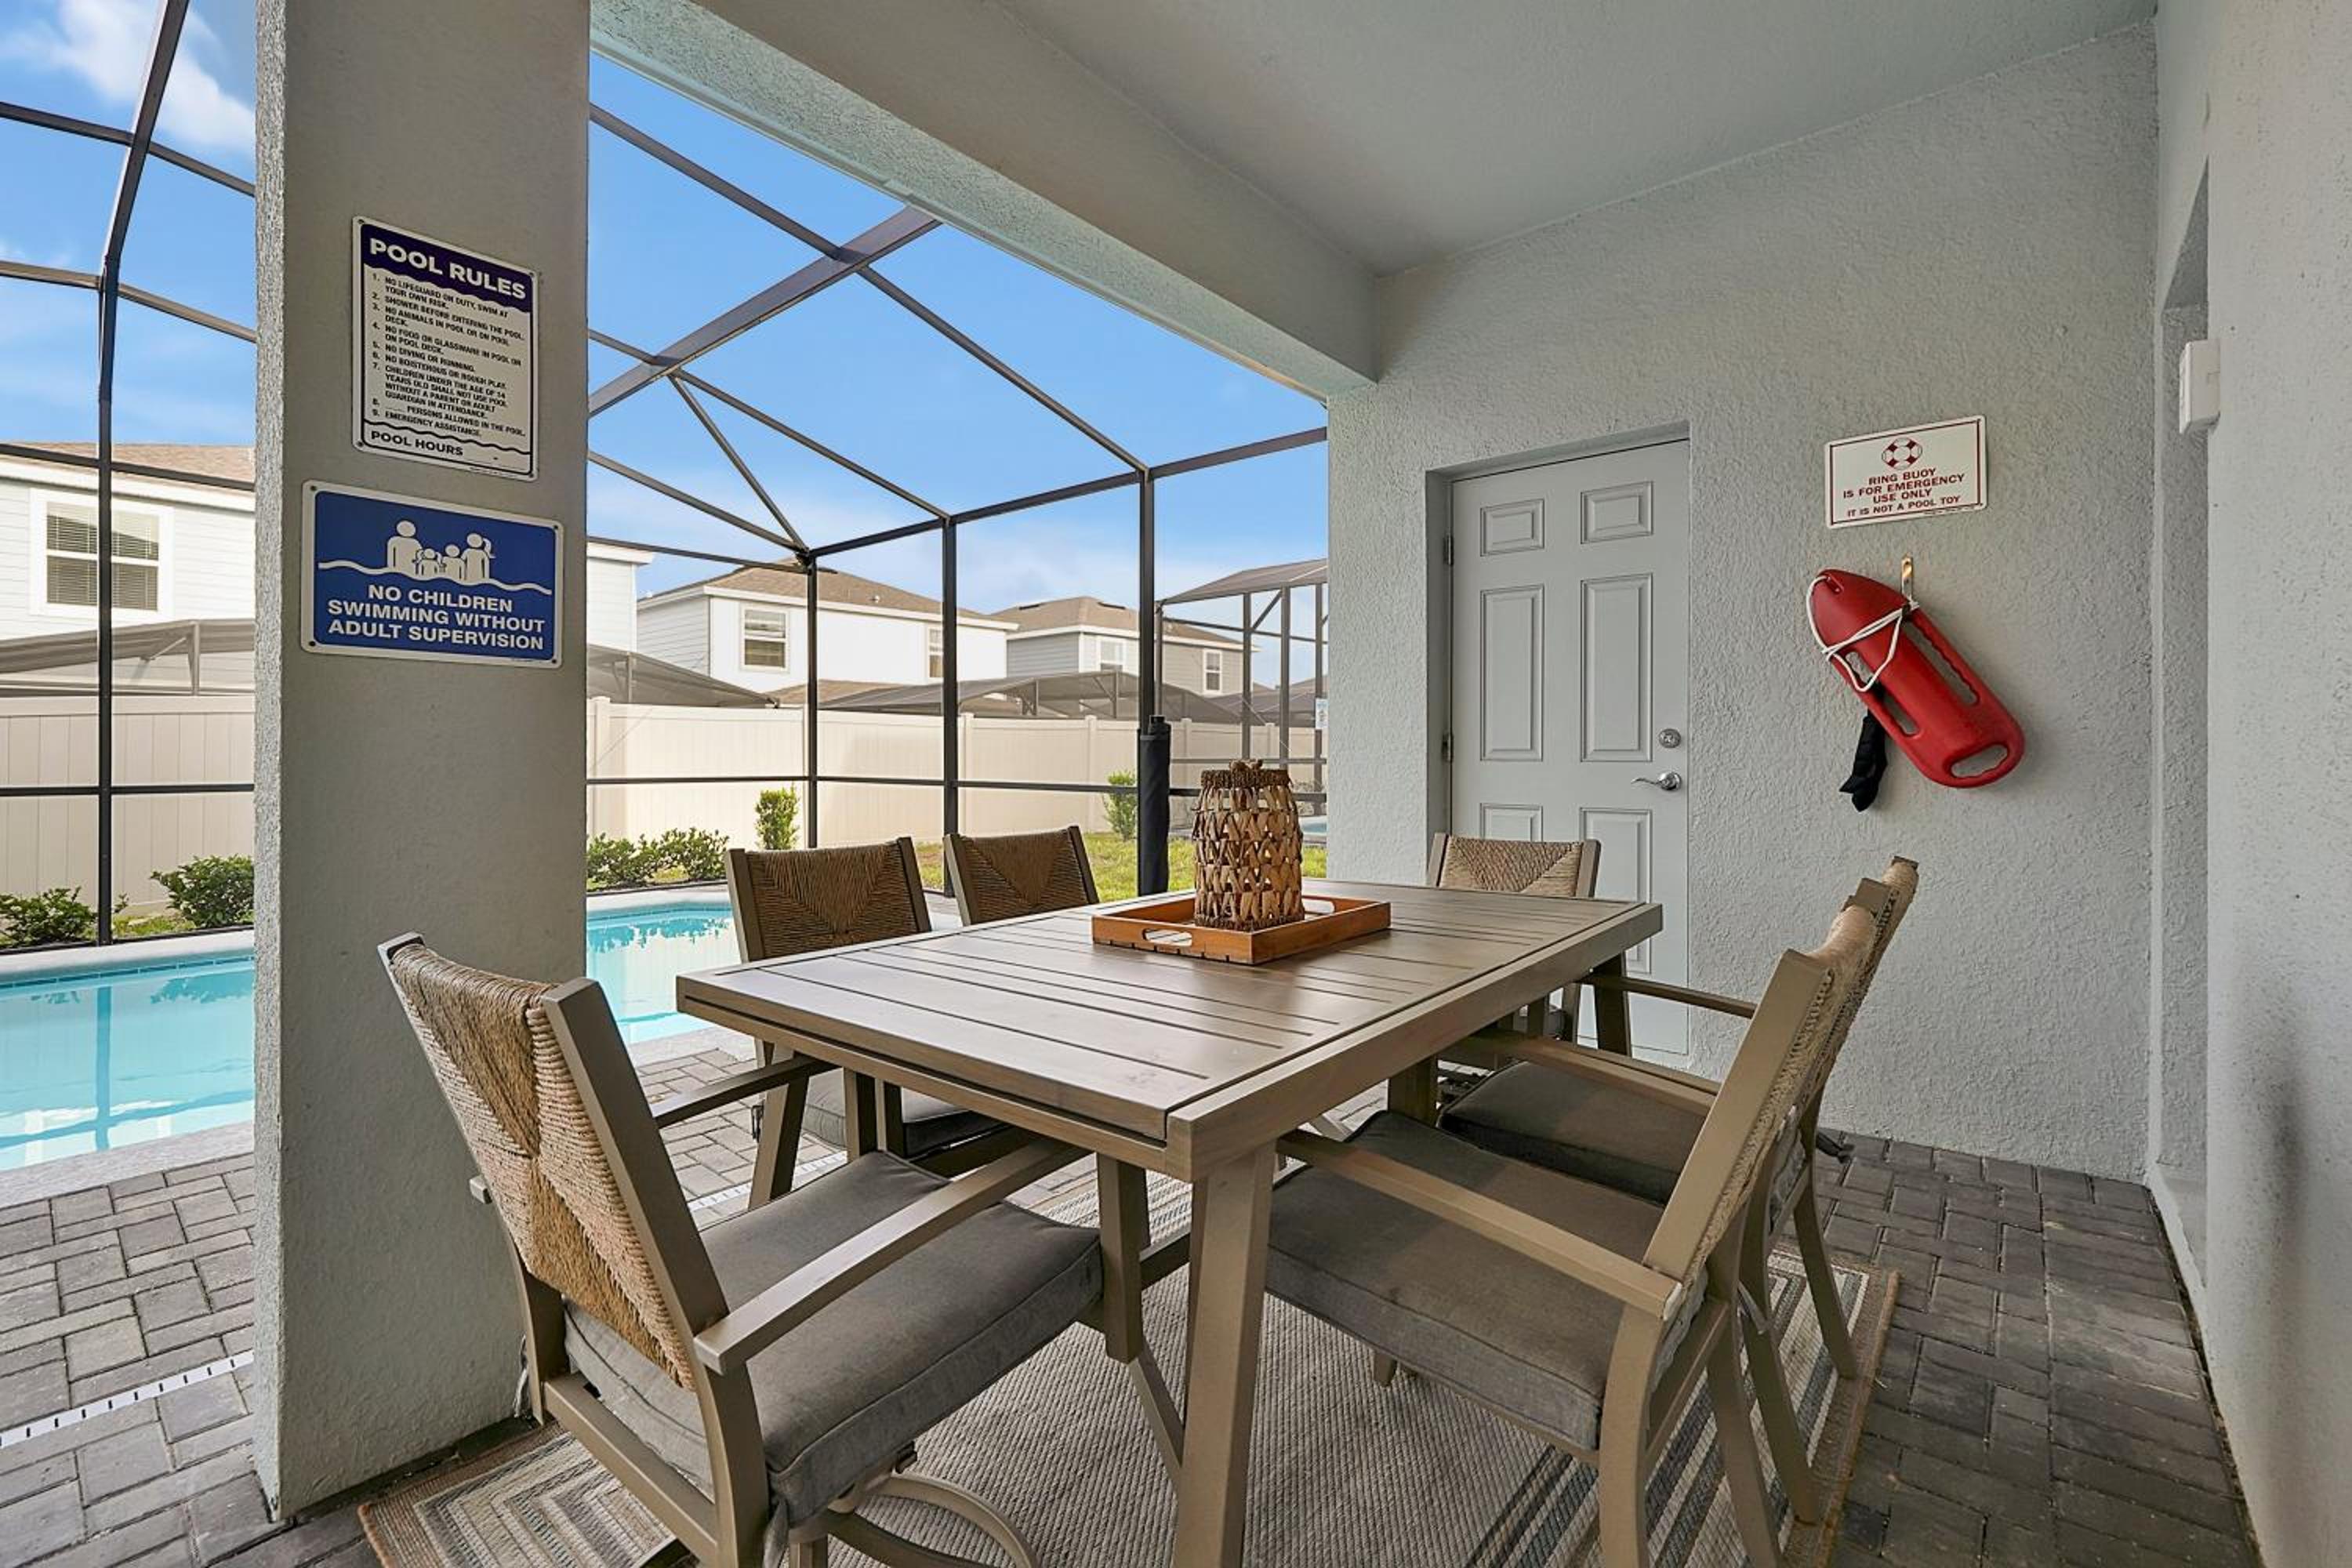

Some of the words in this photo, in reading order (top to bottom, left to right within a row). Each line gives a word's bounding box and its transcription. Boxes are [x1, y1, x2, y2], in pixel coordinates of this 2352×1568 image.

[369, 238, 443, 275] POOL
[449, 261, 526, 300] RULES
[372, 273, 379, 281] 1.
[385, 277, 397, 285] NO
[398, 281, 441, 298] LIFEGUARD
[443, 294, 453, 303] ON
[477, 304, 498, 315] SWIM
[385, 285, 407, 297] YOUR
[408, 292, 427, 303] OWN
[429, 298, 449, 309] RISK.
[372, 303, 379, 311] 3.
[385, 306, 397, 315] NO
[398, 310, 434, 325] ANIMALS
[445, 322, 464, 334] POOL
[466, 328, 477, 337] OR
[491, 336, 510, 346] POOL
[385, 296, 419, 310] SHOWER
[420, 306, 449, 319] BEFORE
[452, 314, 488, 330] ENTERING
[489, 325, 502, 334] THE
[504, 329, 524, 340] POOL.
[385, 314, 408, 326] DECK.
[372, 340, 379, 349] 5.
[385, 343, 397, 353] NO
[399, 347, 425, 360] DIVING
[427, 354, 437, 363] OR
[385, 333, 397, 342] ON
[398, 336, 419, 348] POOL
[421, 343, 444, 354] DECK.
[385, 325, 397, 334] NO
[398, 328, 419, 339] FOOD
[434, 338, 480, 356] GLASSWARE
[491, 352, 510, 364] POOL
[372, 351, 379, 360] 6.
[385, 354, 397, 363] NO
[399, 357, 447, 376] BOISTEROUS
[448, 369, 459, 378] OR
[461, 372, 486, 384] ROUGH
[372, 361, 379, 370] 7.
[385, 365, 424, 379] CHILDREN
[426, 374, 452, 387] UNDER
[454, 380, 467, 390] THE
[469, 384, 484, 394] AGE
[385, 373, 412, 385] YEARS
[413, 380, 429, 389] OLD
[430, 383, 454, 395] SHALL
[456, 390, 470, 398] NOT
[473, 394, 488, 402] USE
[489, 397, 508, 408] POOL
[385, 382, 421, 395] WITHOUT
[430, 391, 459, 404] PARENT
[473, 401, 495, 413] ADULT
[385, 390, 426, 405] GUARDIAN
[372, 408, 379, 417] 9.
[385, 410, 433, 427] EMERGENCY
[407, 405, 442, 419] PERSONS
[445, 413, 479, 427] ALLOWED
[371, 430, 412, 447] POOL
[415, 438, 464, 456] HOURS
[1843, 490, 1854, 499] IS
[1859, 485, 1882, 497] FOR
[1887, 474, 1965, 492] EMERGENCY
[1868, 473, 1898, 485] RING
[1903, 468, 1936, 481] BUOY
[1873, 493, 1896, 504] USE
[1901, 488, 1933, 500] ONLY
[1873, 504, 1893, 514] NOT
[1896, 502, 1905, 510] A
[1908, 499, 1936, 509] POOL
[1940, 495, 1961, 504] TOY
[368, 584, 402, 601] NO
[408, 588, 513, 613] CHILDREN
[328, 599, 449, 625] SWIMMING
[455, 612, 546, 633] WITHOUT
[328, 619, 402, 639] ADULT
[408, 626, 543, 651] SUPERVISION
